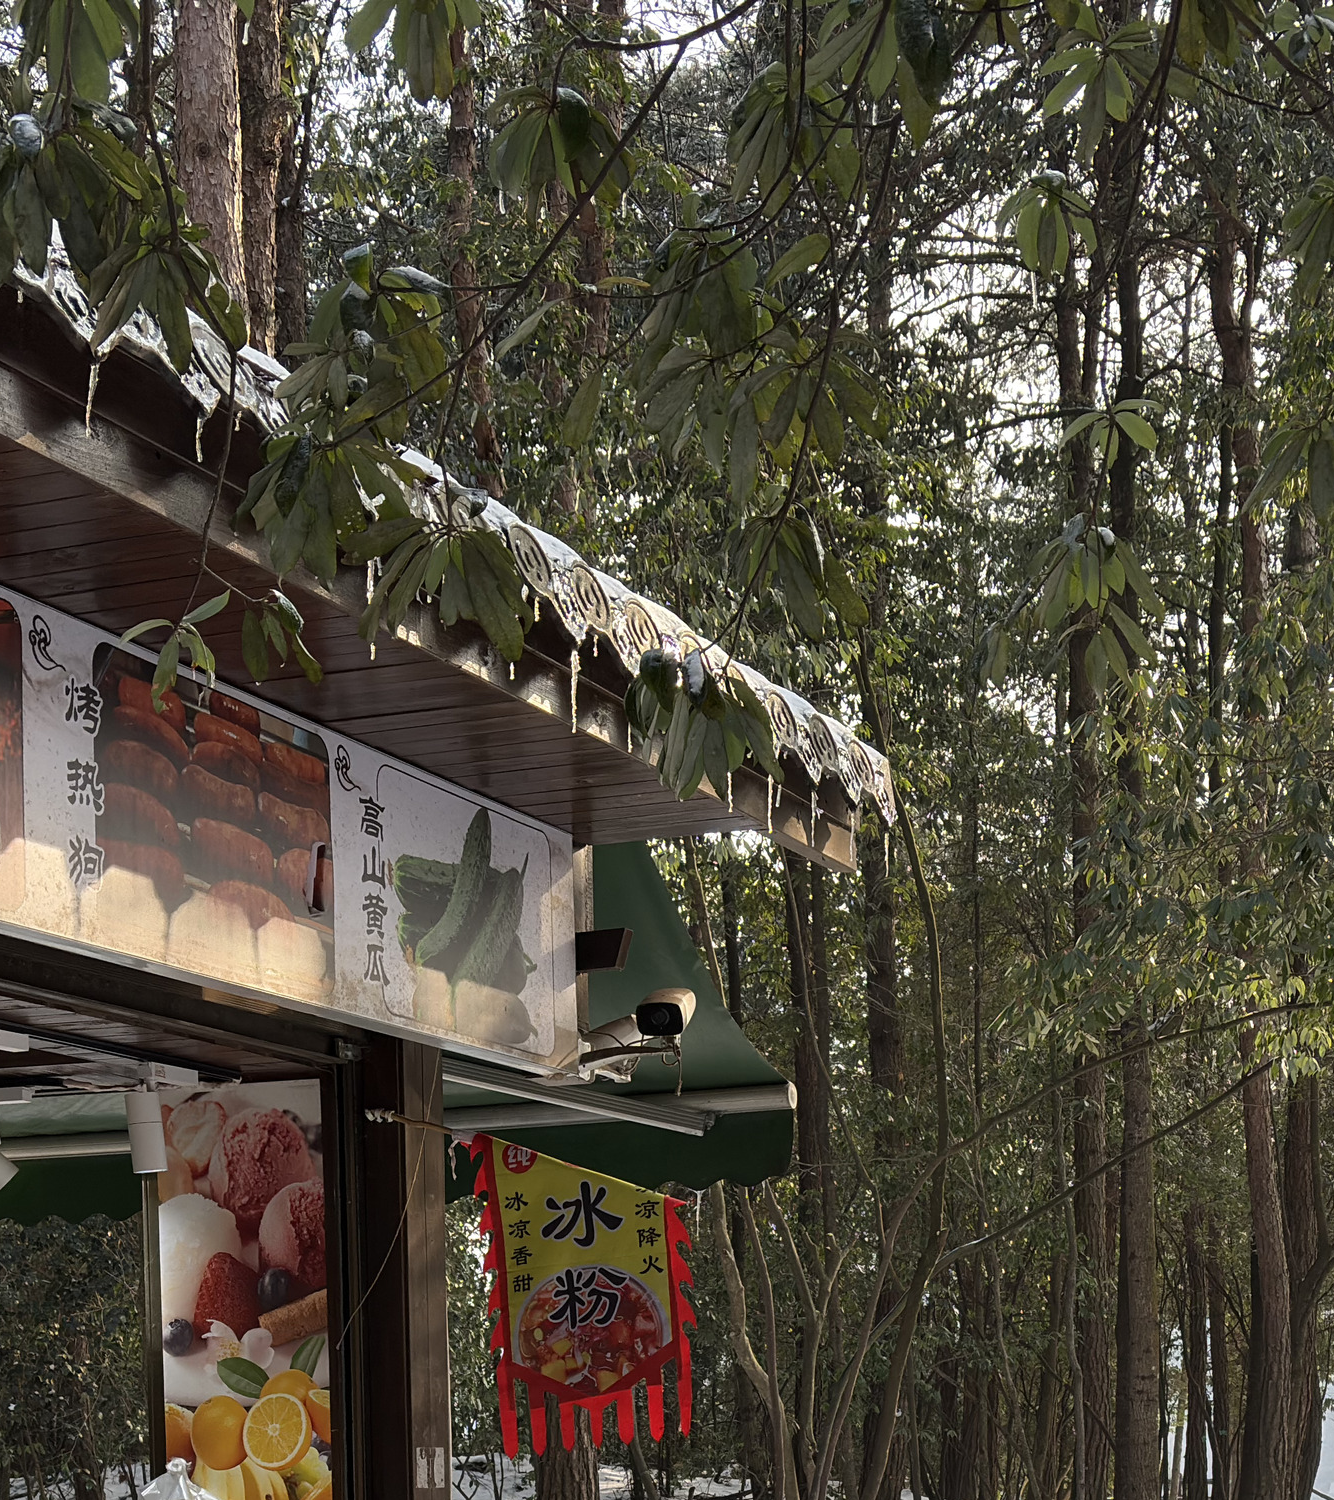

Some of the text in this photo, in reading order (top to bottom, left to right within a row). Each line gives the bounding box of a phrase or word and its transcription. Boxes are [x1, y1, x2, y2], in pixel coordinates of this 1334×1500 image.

[65, 681, 104, 890] 烤热狗
[359, 797, 390, 987] 高山黄瓜
[504, 1191, 533, 1293] 冰凉香甜
[541, 1180, 628, 1329] 冰粉
[635, 1187, 664, 1275] 凉降火
